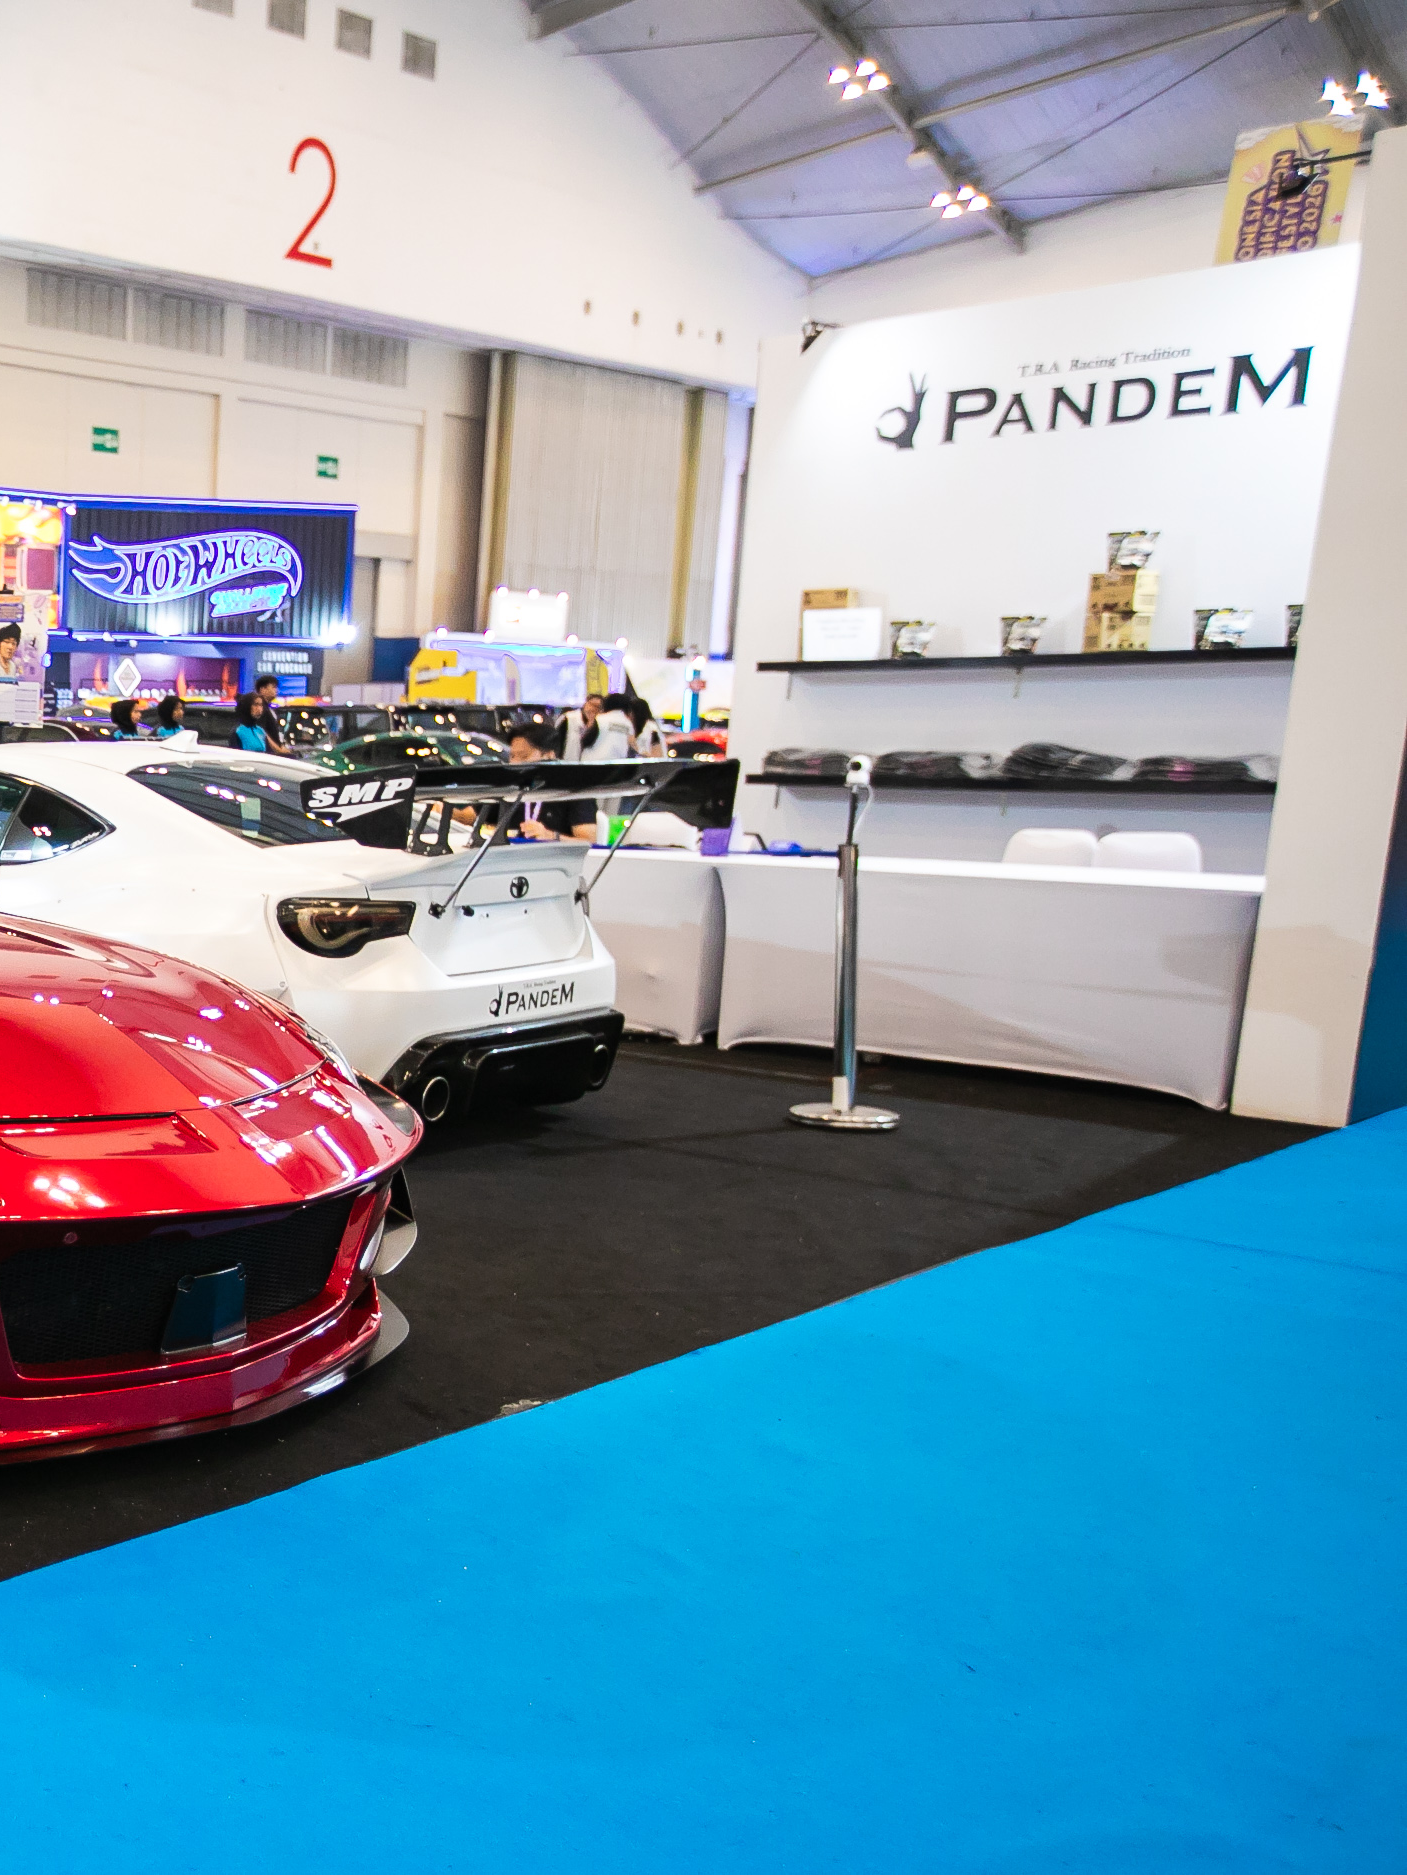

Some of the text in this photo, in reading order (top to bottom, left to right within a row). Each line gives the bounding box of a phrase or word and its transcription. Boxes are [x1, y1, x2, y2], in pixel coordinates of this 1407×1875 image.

[284, 137, 336, 269] 2
[1069, 356, 1116, 372] Racing
[1121, 347, 1191, 365] Tradition
[940, 346, 1315, 445] PANDEM
[114, 547, 195, 597] HOT
[308, 776, 412, 809] SMP
[505, 981, 575, 1015] PANDEM
